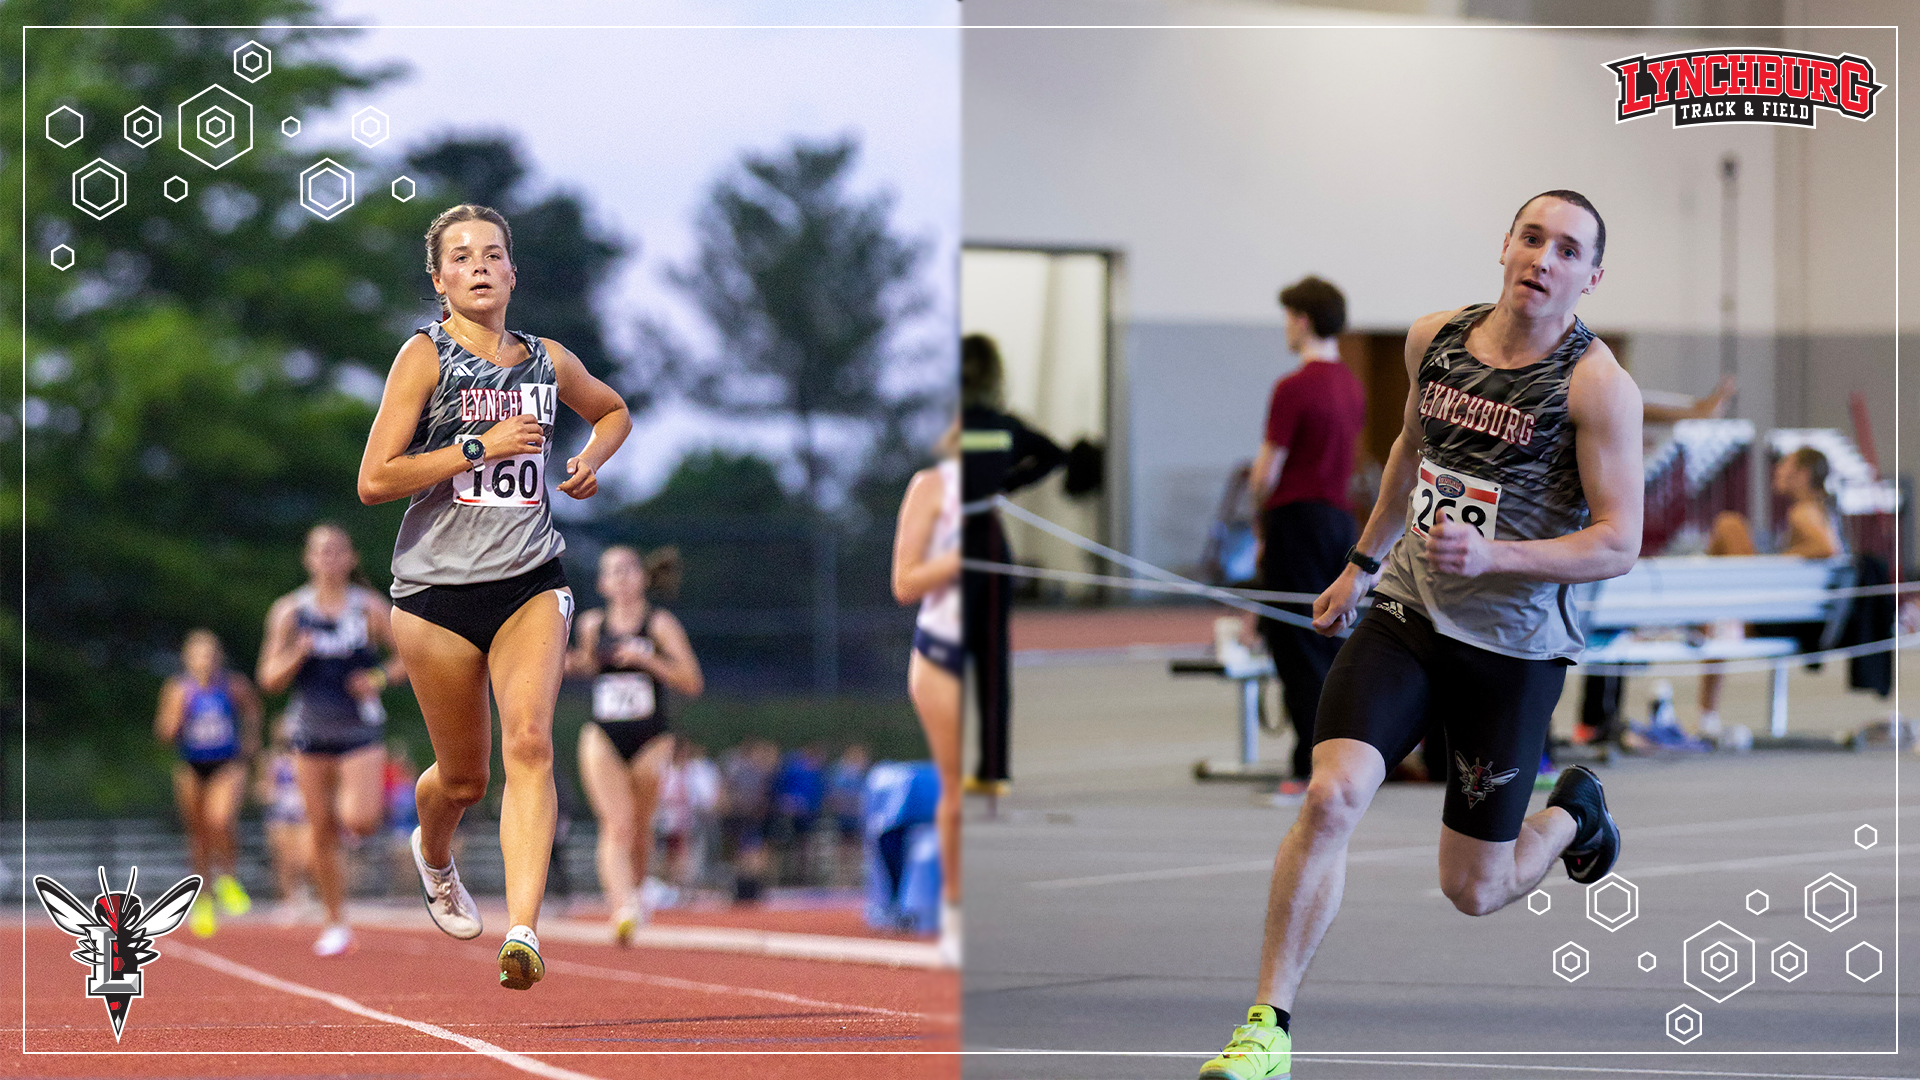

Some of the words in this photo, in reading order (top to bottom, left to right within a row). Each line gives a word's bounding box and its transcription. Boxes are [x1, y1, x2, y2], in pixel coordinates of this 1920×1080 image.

[460, 388, 524, 422] LYNCH
[529, 385, 555, 424] 14
[1419, 380, 1538, 447] LYNCHBURG
[466, 458, 538, 499] 160
[1417, 488, 1487, 538] 268
